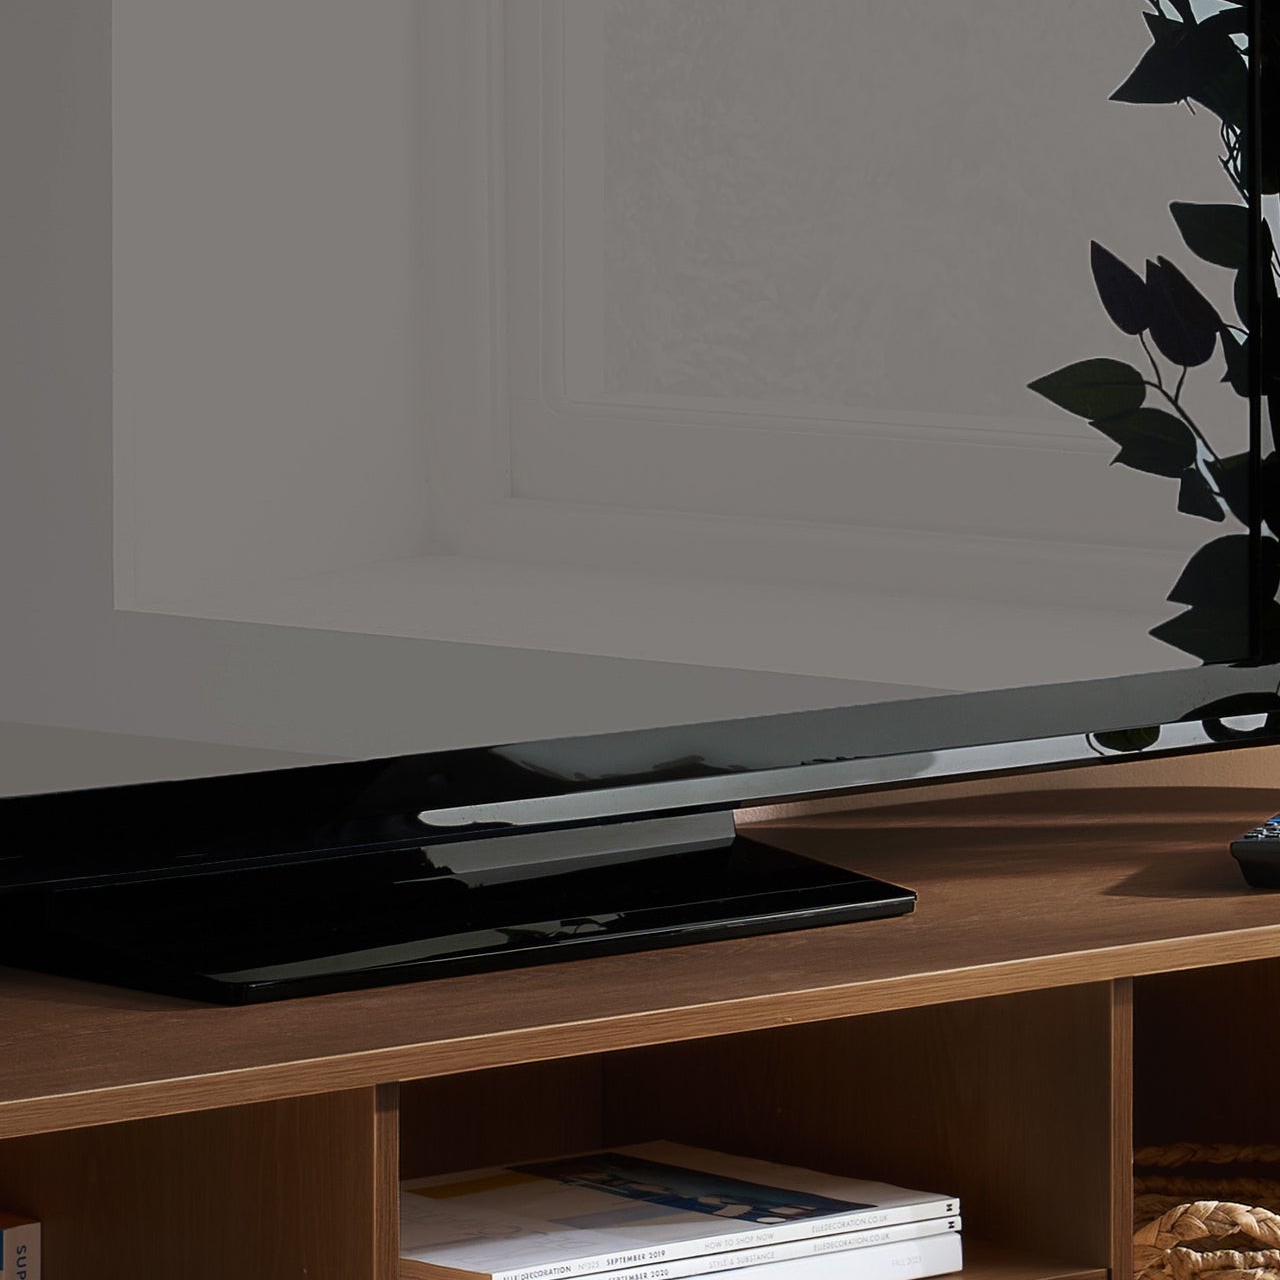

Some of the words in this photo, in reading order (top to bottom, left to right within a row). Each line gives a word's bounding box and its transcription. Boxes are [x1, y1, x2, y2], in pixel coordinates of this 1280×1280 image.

[704, 1241, 722, 1251] HOW
[724, 1239, 734, 1247] TO
[736, 1235, 754, 1246] SHOP
[756, 1232, 775, 1242] NOW
[606, 1252, 646, 1267] SEPTEMBER
[648, 1249, 666, 1260] 2019
[708, 1259, 728, 1270] STYLE
[736, 1251, 775, 1265] SUBSTANCE
[650, 1268, 669, 1279] 2020
